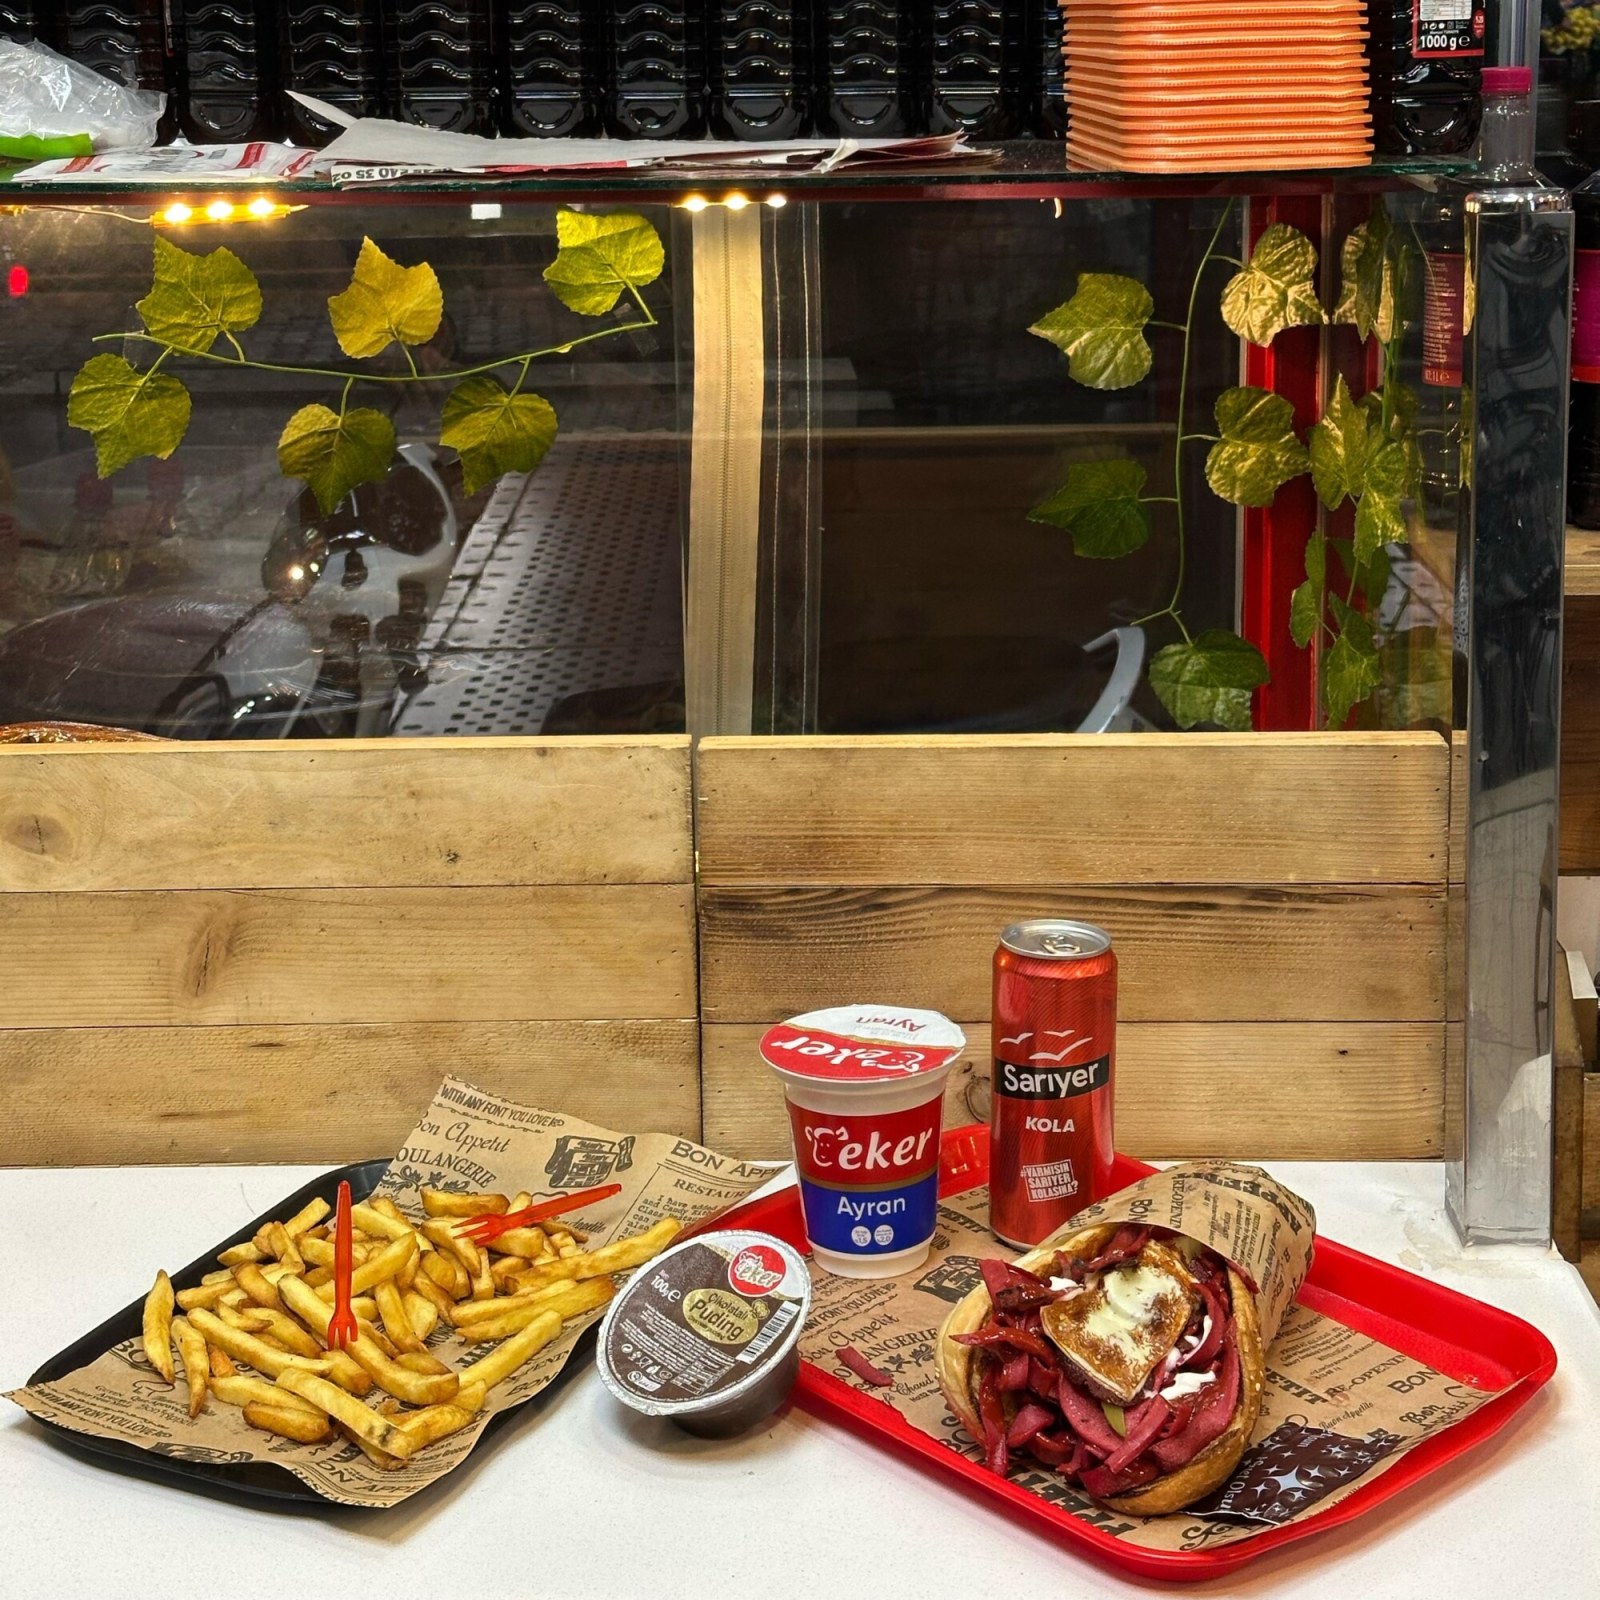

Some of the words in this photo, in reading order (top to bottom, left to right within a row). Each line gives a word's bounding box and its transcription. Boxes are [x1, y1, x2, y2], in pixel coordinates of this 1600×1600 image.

[1420, 35, 1447, 48] 1000
[1450, 36, 1457, 50] g
[856, 1016, 926, 1033] Ayran
[1003, 1063, 1099, 1098] Sarıyer
[441, 1083, 466, 1106] WITH
[465, 1095, 484, 1114] ANY
[482, 1101, 508, 1118] FONT
[508, 1107, 527, 1124] YOU
[1025, 1116, 1075, 1133] KOLA
[445, 1121, 511, 1153] Appetit
[670, 1140, 724, 1170] BON
[642, 1198, 661, 1208] and
[665, 1197, 688, 1209] have
[837, 1196, 906, 1221] Ayran
[633, 1213, 650, 1223] can
[688, 1299, 744, 1342] Puding
[818, 1306, 843, 1322] FONT
[828, 1313, 900, 1348] Appetit
[1387, 1367, 1441, 1394] BON
[82, 1404, 109, 1421] FONT
[1399, 1402, 1445, 1424] Bon
